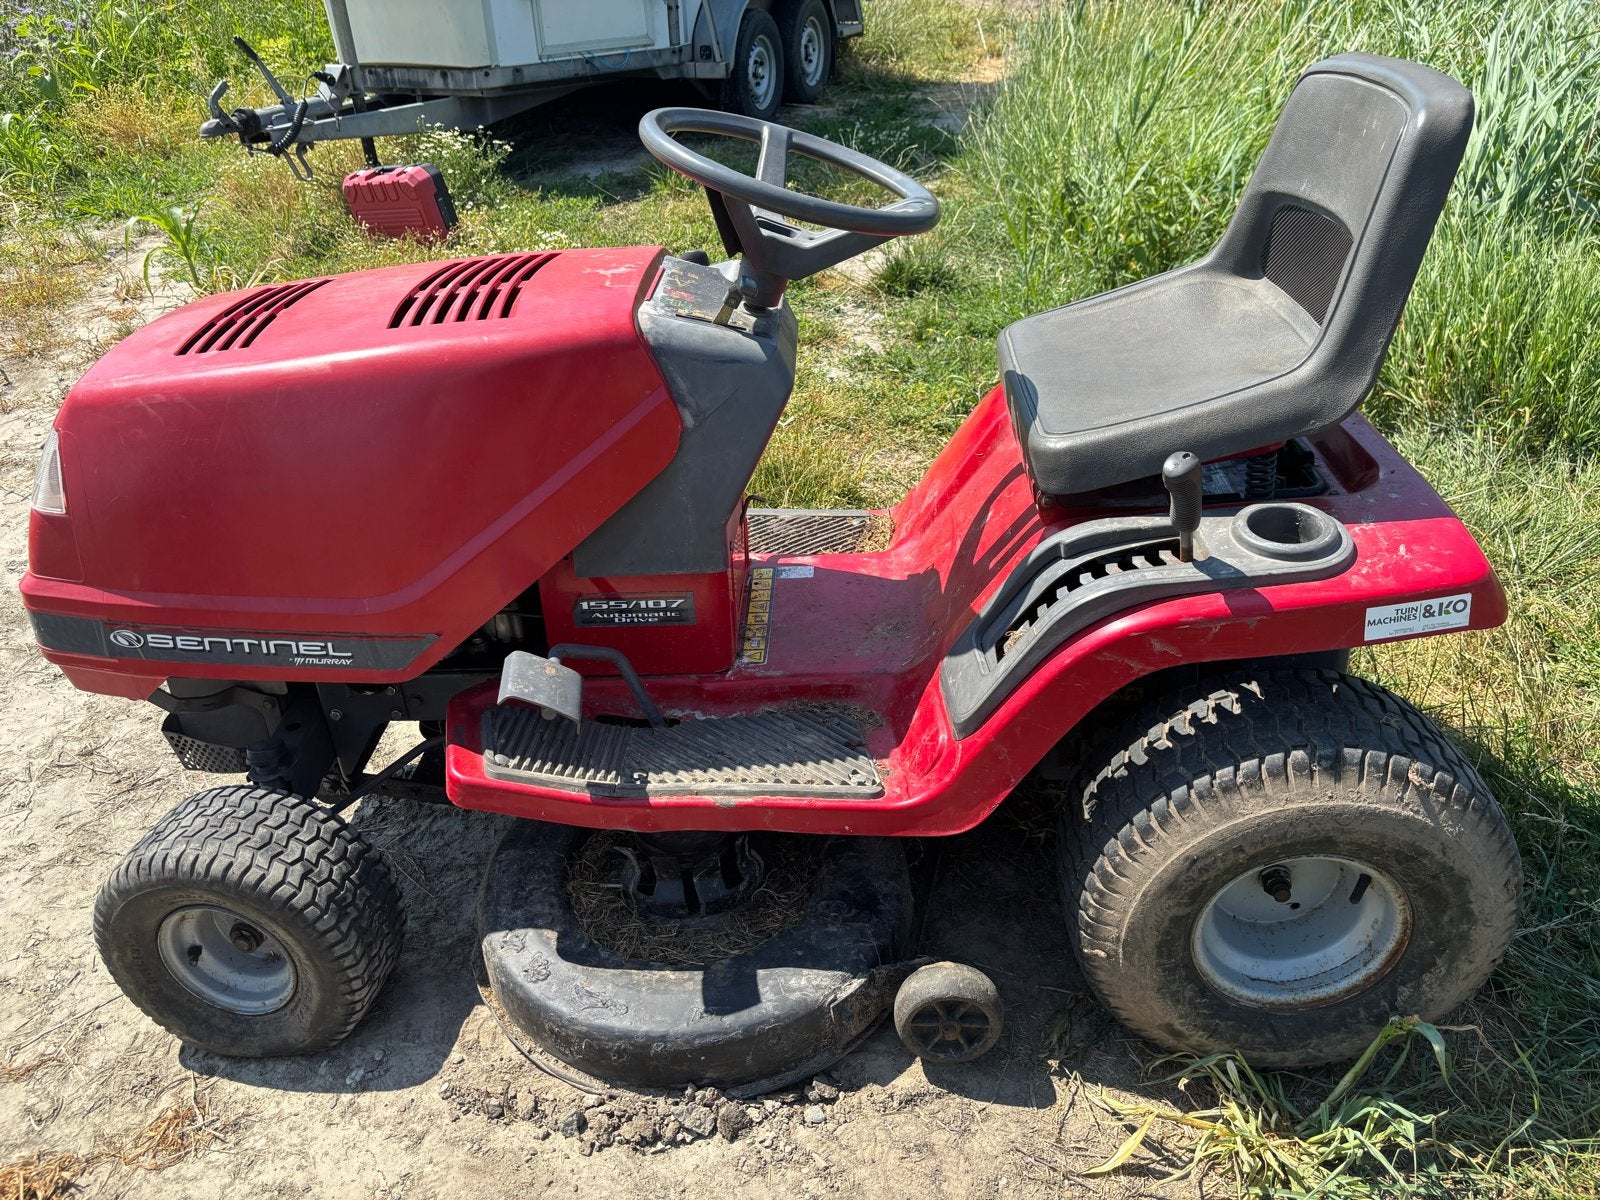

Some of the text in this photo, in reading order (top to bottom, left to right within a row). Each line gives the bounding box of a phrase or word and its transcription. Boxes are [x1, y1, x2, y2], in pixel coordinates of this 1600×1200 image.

[580, 599, 685, 610] 155/107
[1395, 606, 1419, 616] TUIN
[1367, 613, 1417, 627] MACHINES
[146, 633, 353, 657] SENTINEL
